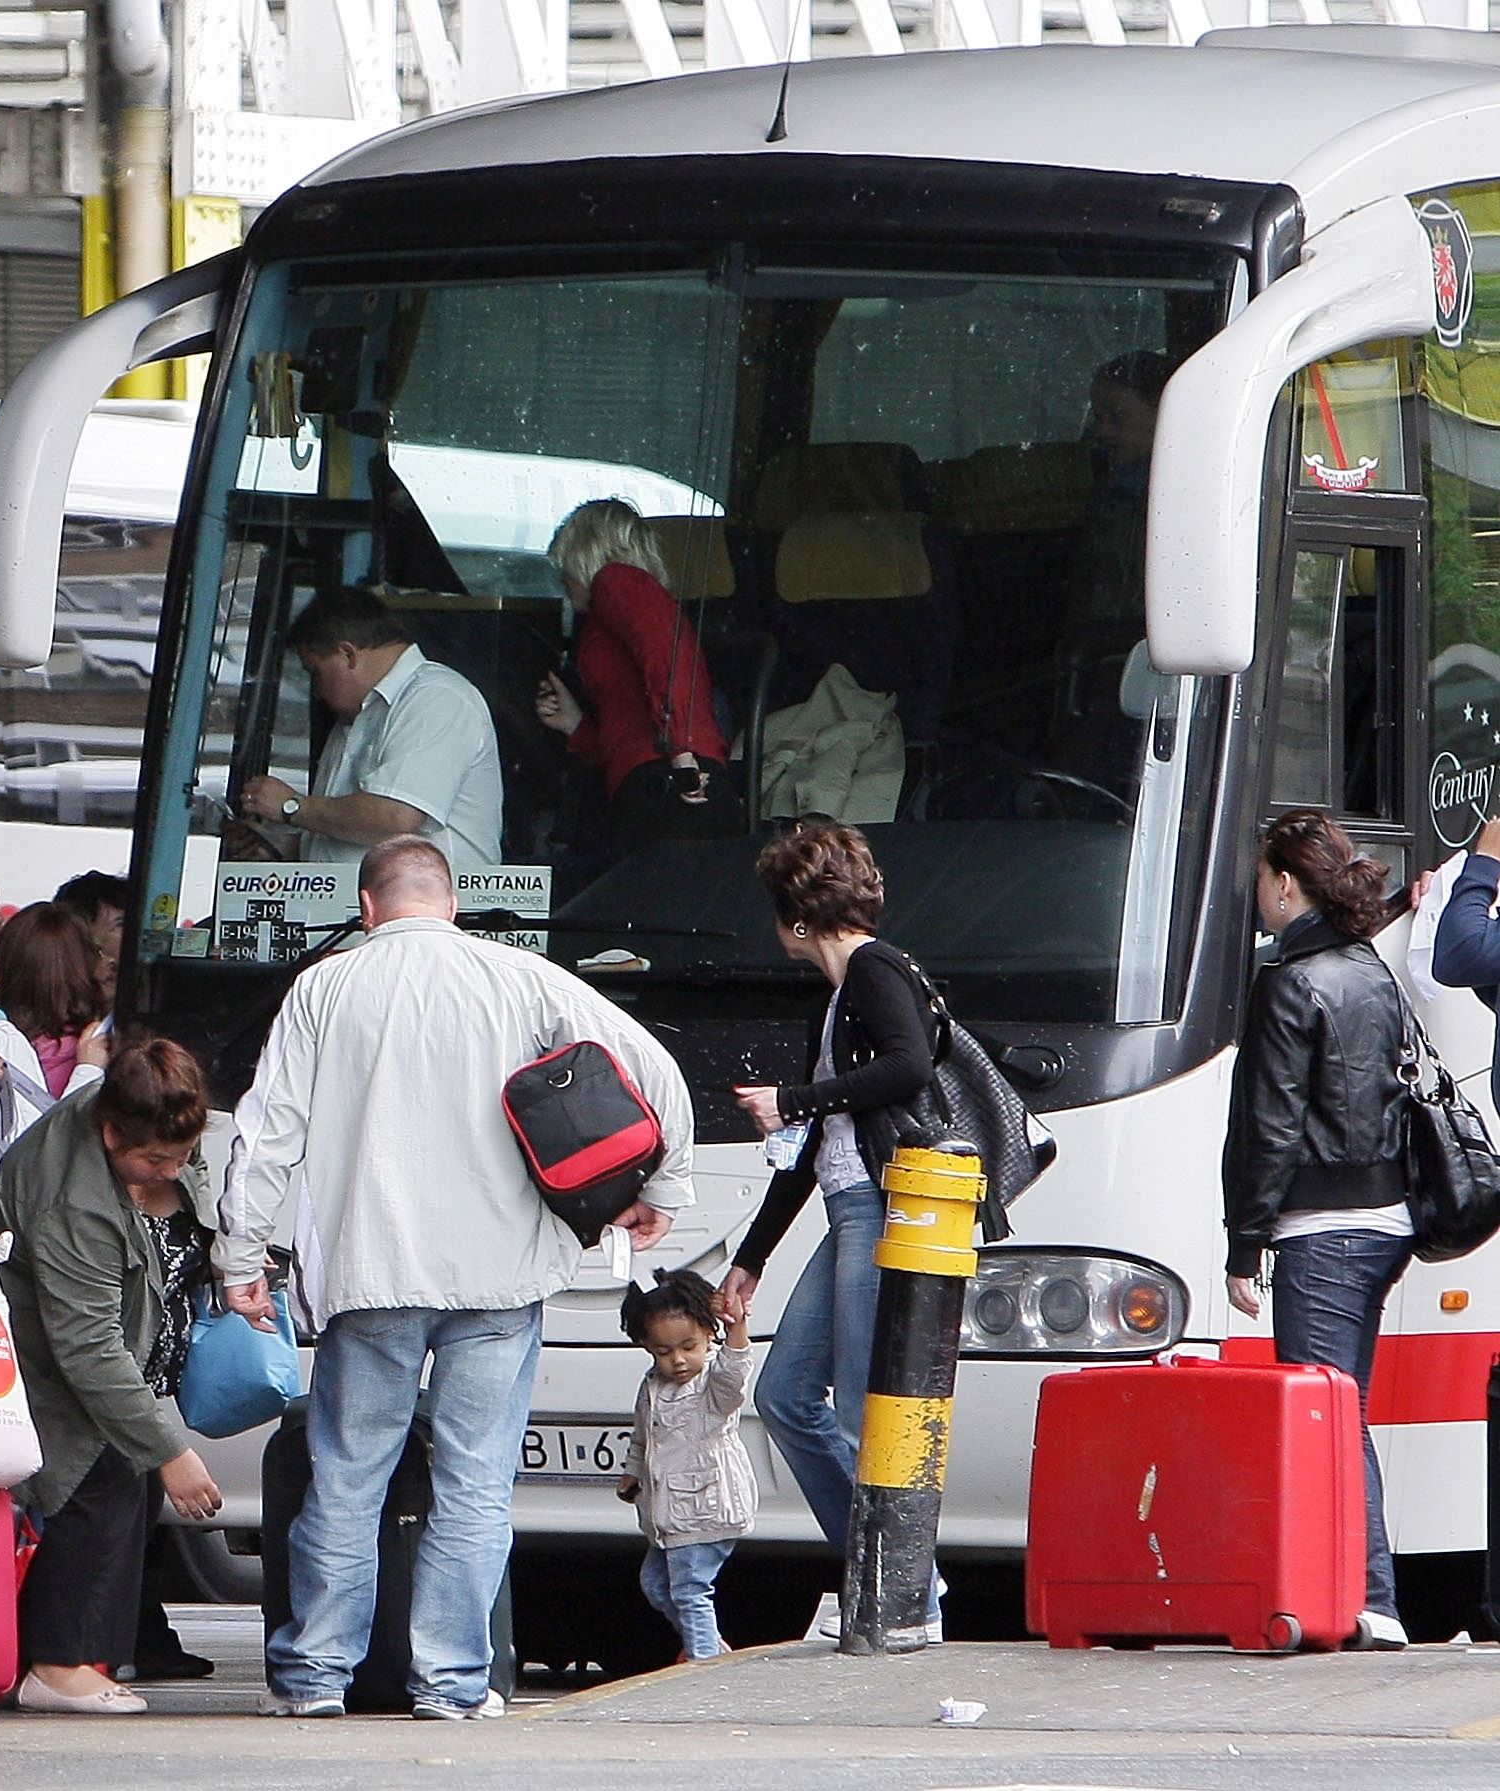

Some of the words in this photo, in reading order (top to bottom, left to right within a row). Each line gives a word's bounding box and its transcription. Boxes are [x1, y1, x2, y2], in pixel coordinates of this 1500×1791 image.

[458, 874, 543, 890] BRYTANIA
[472, 895, 508, 904] LONDYN
[512, 896, 543, 905] DOVER
[249, 903, 284, 919] E-193
[221, 925, 258, 940] E-194
[272, 925, 305, 940] E-19
[220, 947, 257, 961] E-196
